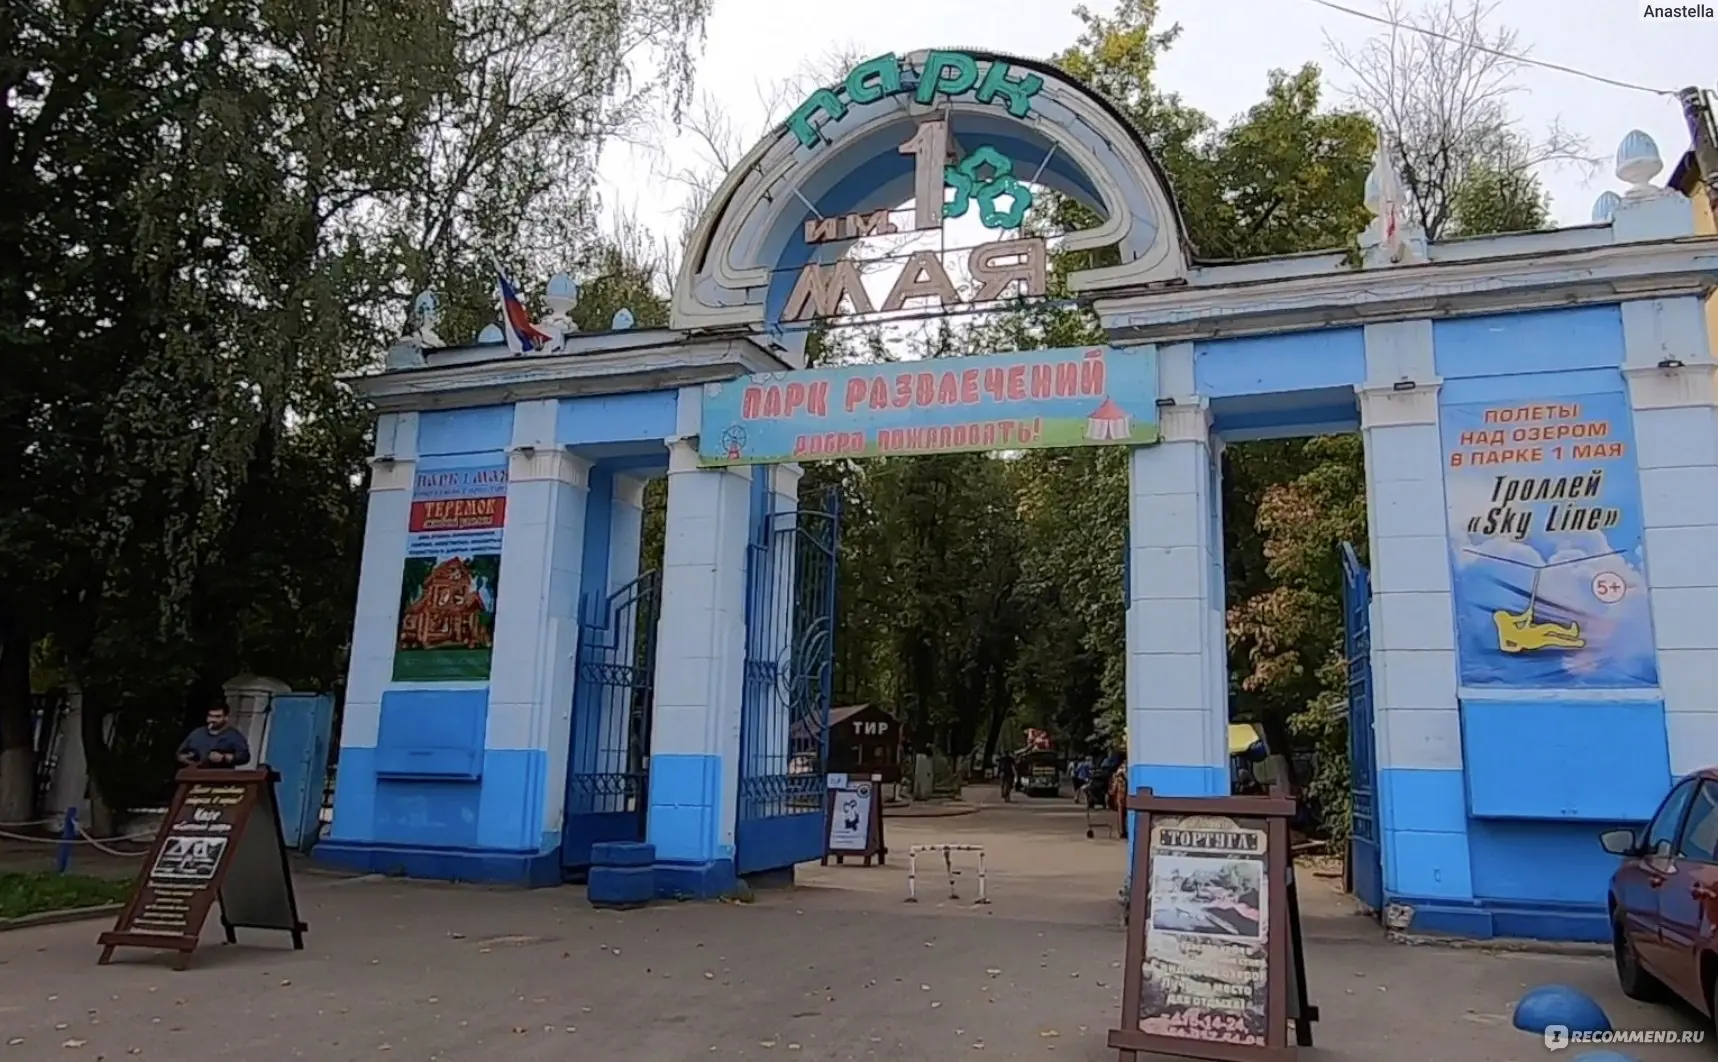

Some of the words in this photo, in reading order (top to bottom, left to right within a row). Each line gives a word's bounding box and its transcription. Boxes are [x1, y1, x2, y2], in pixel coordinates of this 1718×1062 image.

[898, 119, 948, 230] 1
[780, 237, 1047, 322] МАЯ
[742, 380, 829, 420] ПАРК
[844, 349, 1105, 413] РАЗВЛЕЧЕНИЙ
[1484, 403, 1578, 424] ПОЛЕТЫ
[793, 431, 864, 457] ДОБРО
[877, 417, 1041, 451] ПОЖАЛОВАТЬ!
[1460, 429, 1505, 447] НАД
[1512, 422, 1607, 442] ОЗЕРОМ
[1450, 452, 1463, 467] В
[1471, 447, 1543, 466] ПАРКЕ
[1551, 447, 1562, 460] 1
[1572, 442, 1623, 460] МАЯ
[1491, 469, 1603, 508] Троллей
[424, 499, 497, 518] ТЕРЕМОК
[1467, 507, 1532, 540] «Sky
[1545, 502, 1619, 532] Line»
[1596, 579, 1621, 596] 5+
[853, 721, 889, 736] ТИР
[1167, 830, 1250, 850] ТОРТУГА
